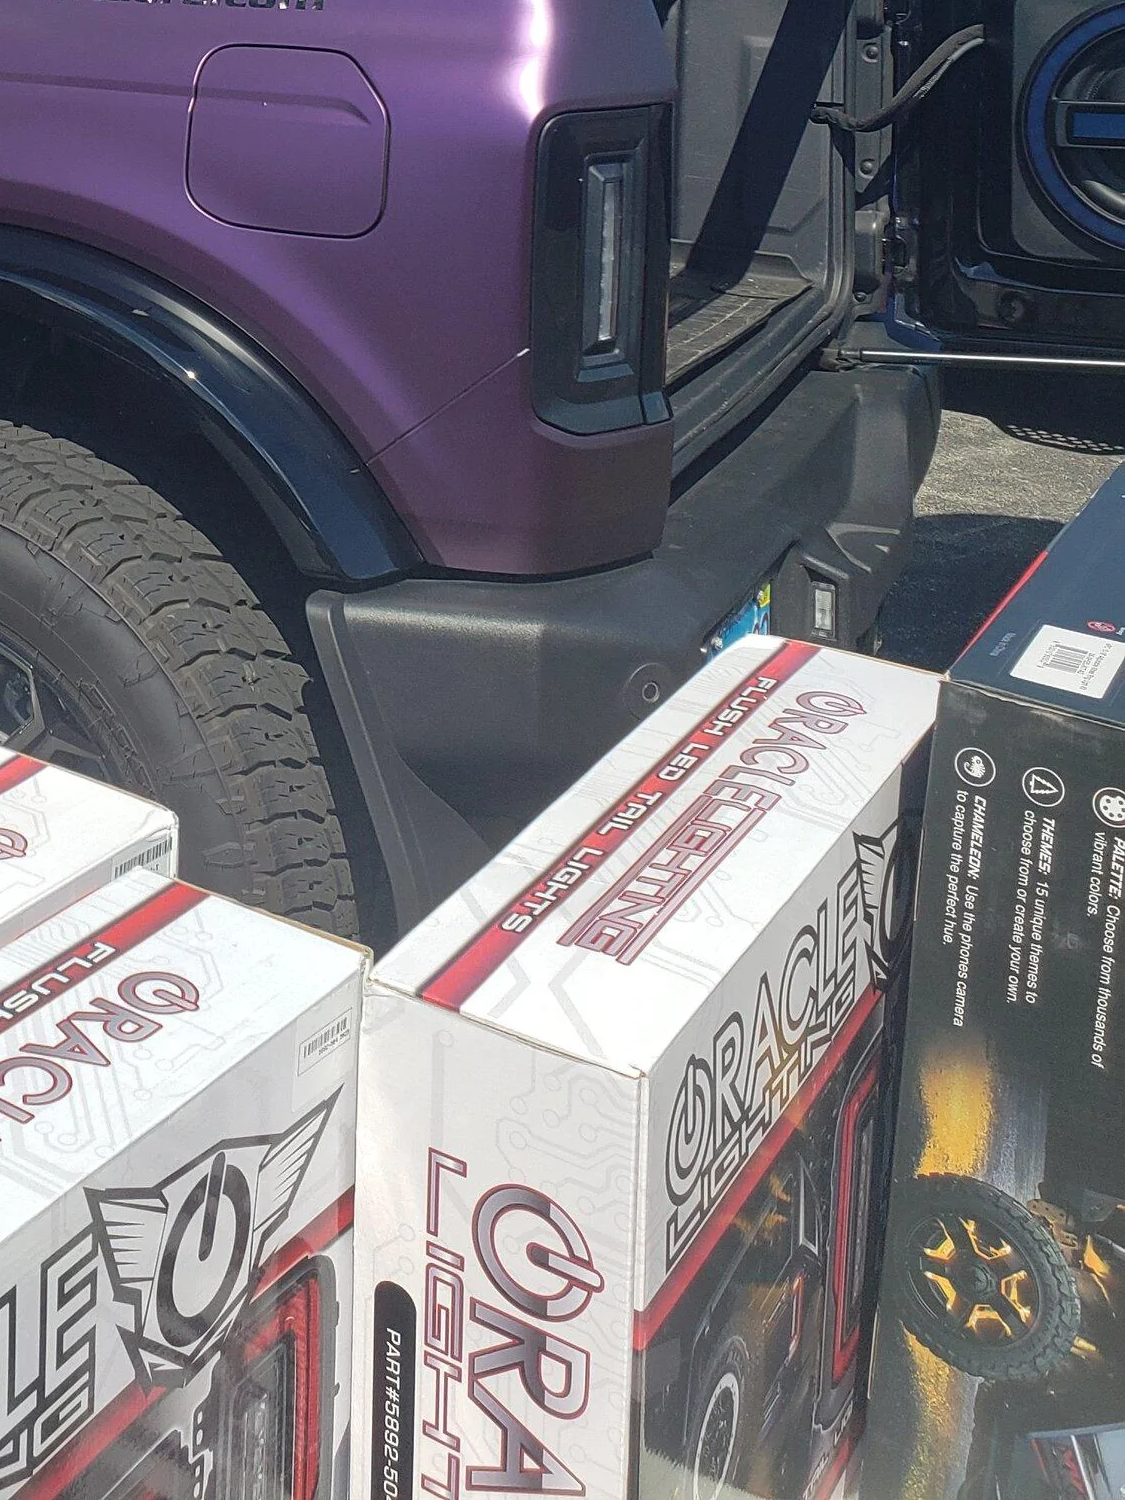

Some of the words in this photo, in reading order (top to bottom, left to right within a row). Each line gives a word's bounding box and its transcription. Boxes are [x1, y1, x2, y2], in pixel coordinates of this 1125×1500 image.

[703, 675, 779, 738] FLUSH
[657, 742, 711, 782] LED
[703, 689, 868, 812] ORACLE
[596, 790, 663, 836] TAIL
[956, 789, 969, 802] to
[951, 802, 966, 851] capture
[967, 794, 987, 880] CHAMELEON:
[1020, 810, 1036, 856] choose
[1037, 816, 1056, 877] THEMES:
[949, 853, 963, 874] the
[1018, 856, 1034, 888] from
[1088, 831, 1105, 876] vibrant
[1108, 835, 1125, 900] PALETTE:
[499, 846, 605, 934] LIGHTS
[944, 874, 960, 919] perfect
[964, 884, 979, 910] Use
[1016, 888, 1028, 903] or
[1035, 880, 1049, 897] 15
[1086, 876, 1102, 917] colors.
[942, 919, 957, 946] hue.
[962, 911, 976, 932] the
[1012, 902, 1026, 944] create
[1030, 897, 1046, 942] unique
[1103, 903, 1121, 954] Choose
[958, 931, 974, 980] phones
[1008, 943, 1023, 975] your
[1027, 942, 1043, 992] themes
[1099, 954, 1115, 987] from
[953, 980, 968, 1028] camera
[1006, 975, 1020, 1004] own.
[1024, 992, 1037, 1005] to
[665, 857, 860, 1208] ORACLE
[1092, 987, 1111, 1052] thousands
[1090, 1052, 1105, 1070] of
[384, 1326, 401, 1500] PART#5892-50
